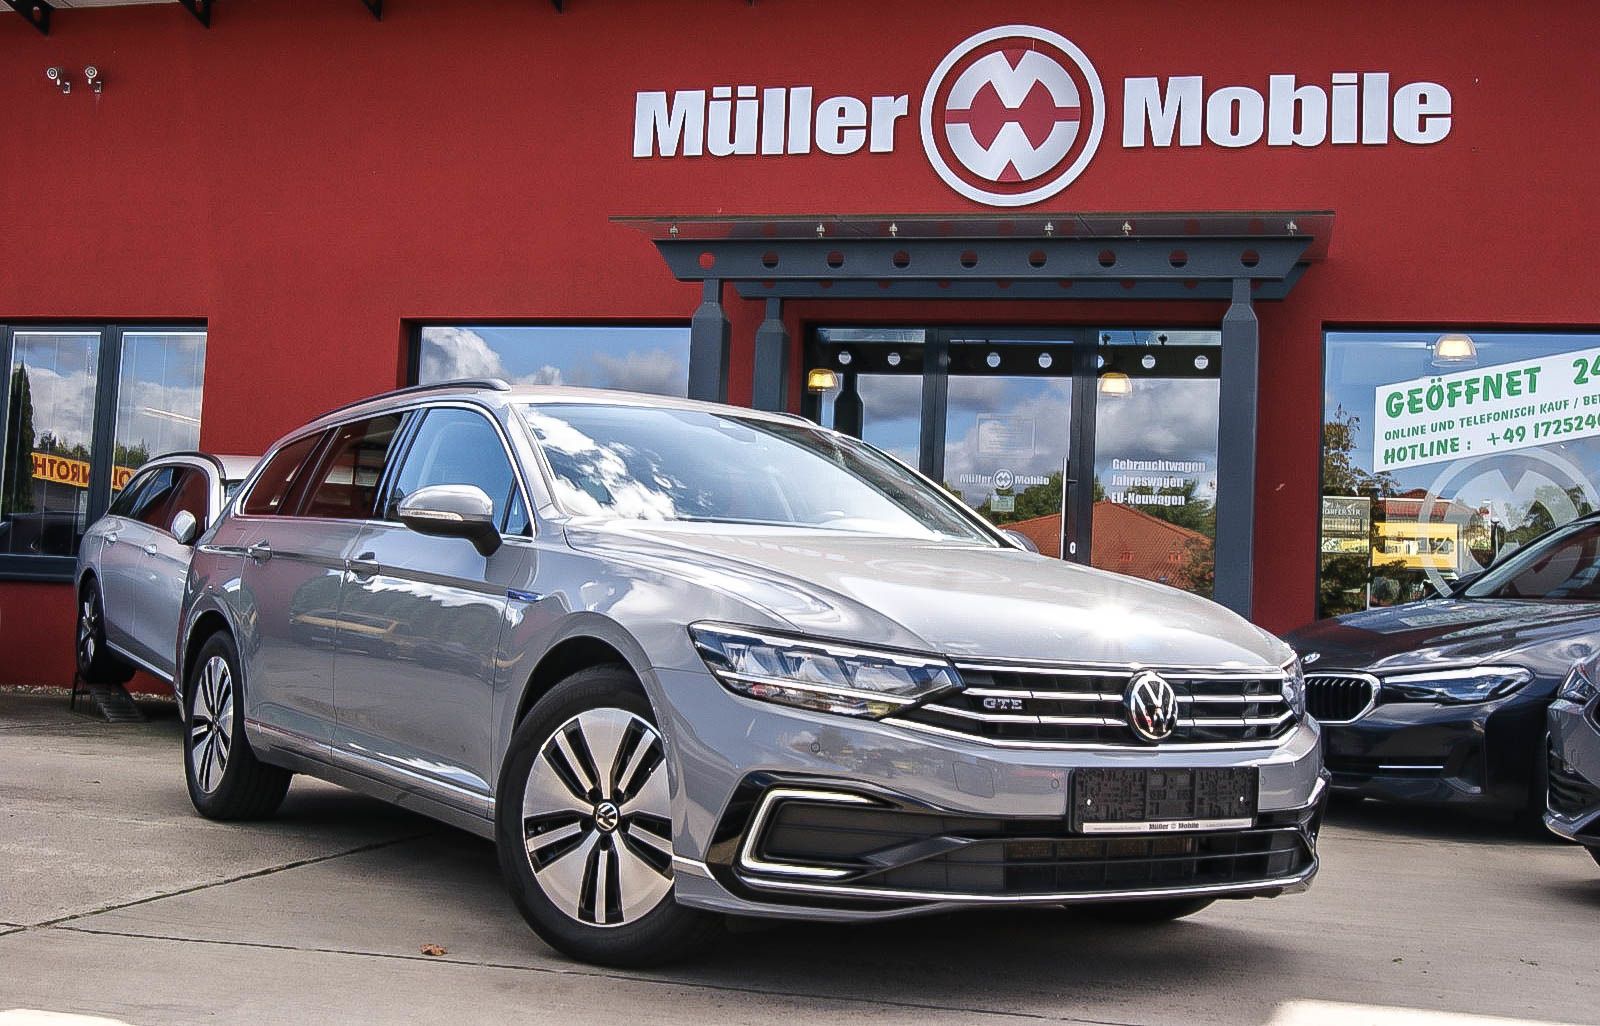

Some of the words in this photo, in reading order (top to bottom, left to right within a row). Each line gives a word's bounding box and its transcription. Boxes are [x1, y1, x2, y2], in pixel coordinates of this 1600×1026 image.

[633, 86, 909, 157] Müller
[1122, 72, 1452, 148] Mobile
[1385, 366, 1542, 418] GEÖFFNET
[1384, 424, 1427, 441] ONLINE
[1430, 419, 1455, 433] UND
[1459, 405, 1535, 428] TELEFONISCH
[1540, 399, 1570, 415] KAUF
[1383, 437, 1460, 465] HOTLINE
[1487, 426, 1526, 446] +49
[1112, 459, 1206, 473] Gebrauchtwagen
[1112, 474, 1184, 488] Jahreswagen
[1111, 491, 1186, 507] EU-Neuwagen
[983, 697, 1023, 710] GTE
